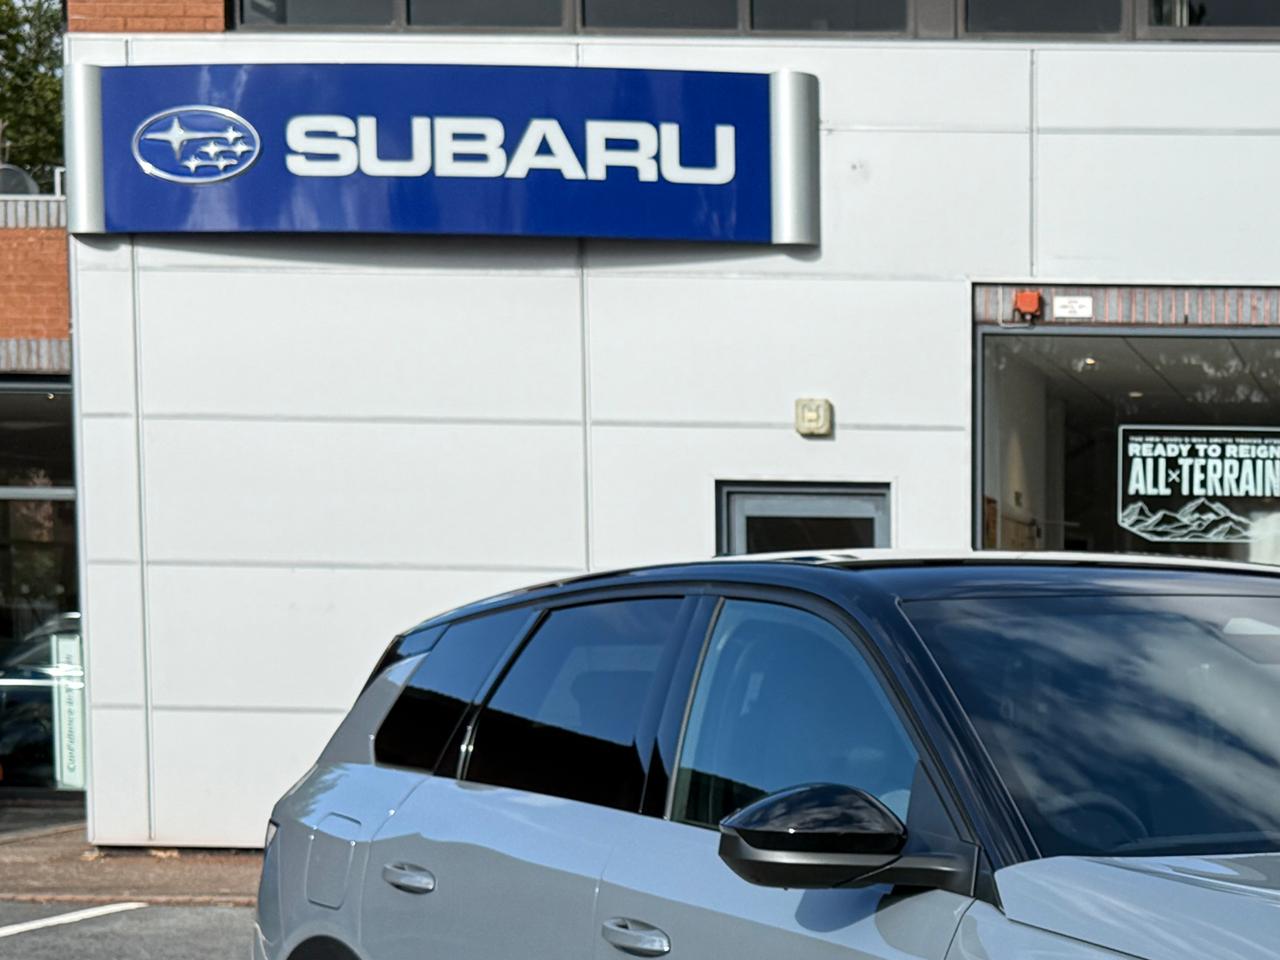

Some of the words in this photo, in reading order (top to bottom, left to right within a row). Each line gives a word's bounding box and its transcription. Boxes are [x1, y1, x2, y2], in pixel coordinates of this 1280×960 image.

[286, 115, 736, 185] SUBARU
[1128, 443, 1191, 457] READY
[1195, 444, 1221, 458] TO
[1128, 457, 1171, 496] ALL
